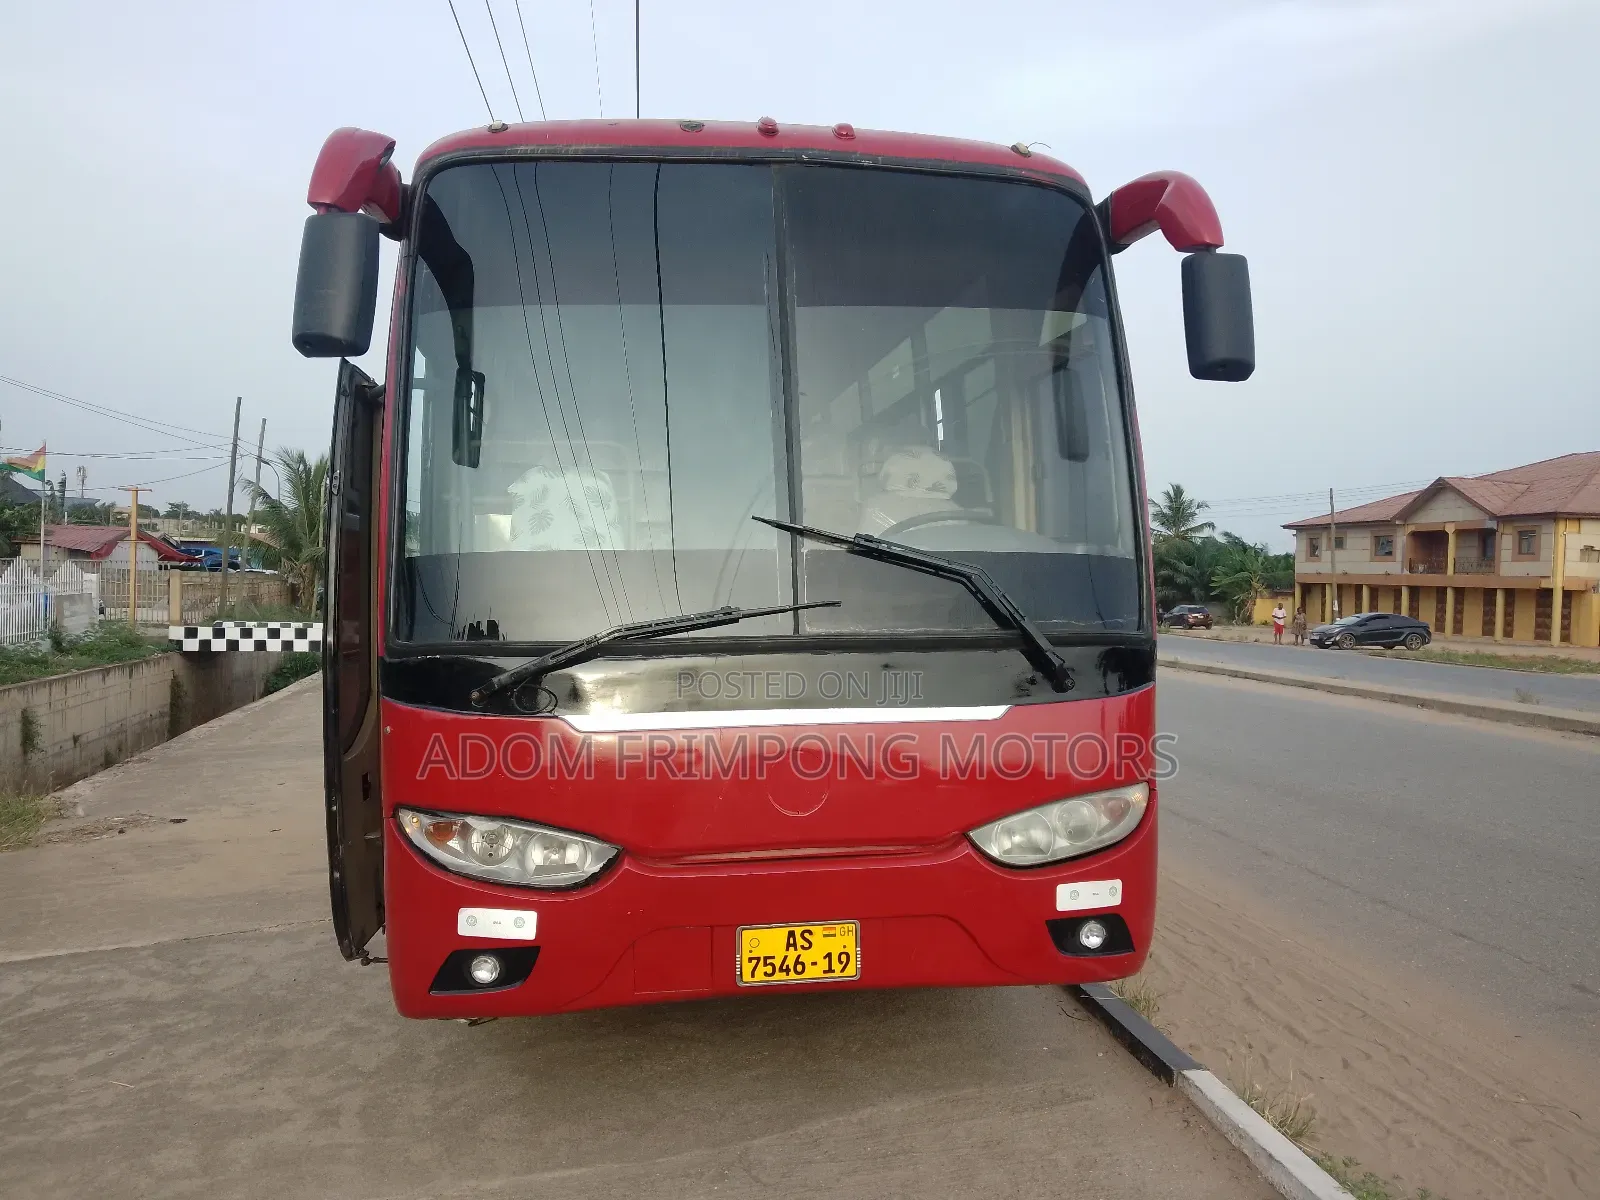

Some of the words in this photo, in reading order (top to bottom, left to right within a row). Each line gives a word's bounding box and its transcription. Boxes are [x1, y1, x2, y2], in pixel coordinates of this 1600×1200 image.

[785, 929, 814, 952] AS
[839, 925, 854, 937] GH
[747, 951, 851, 979] 7546-19
